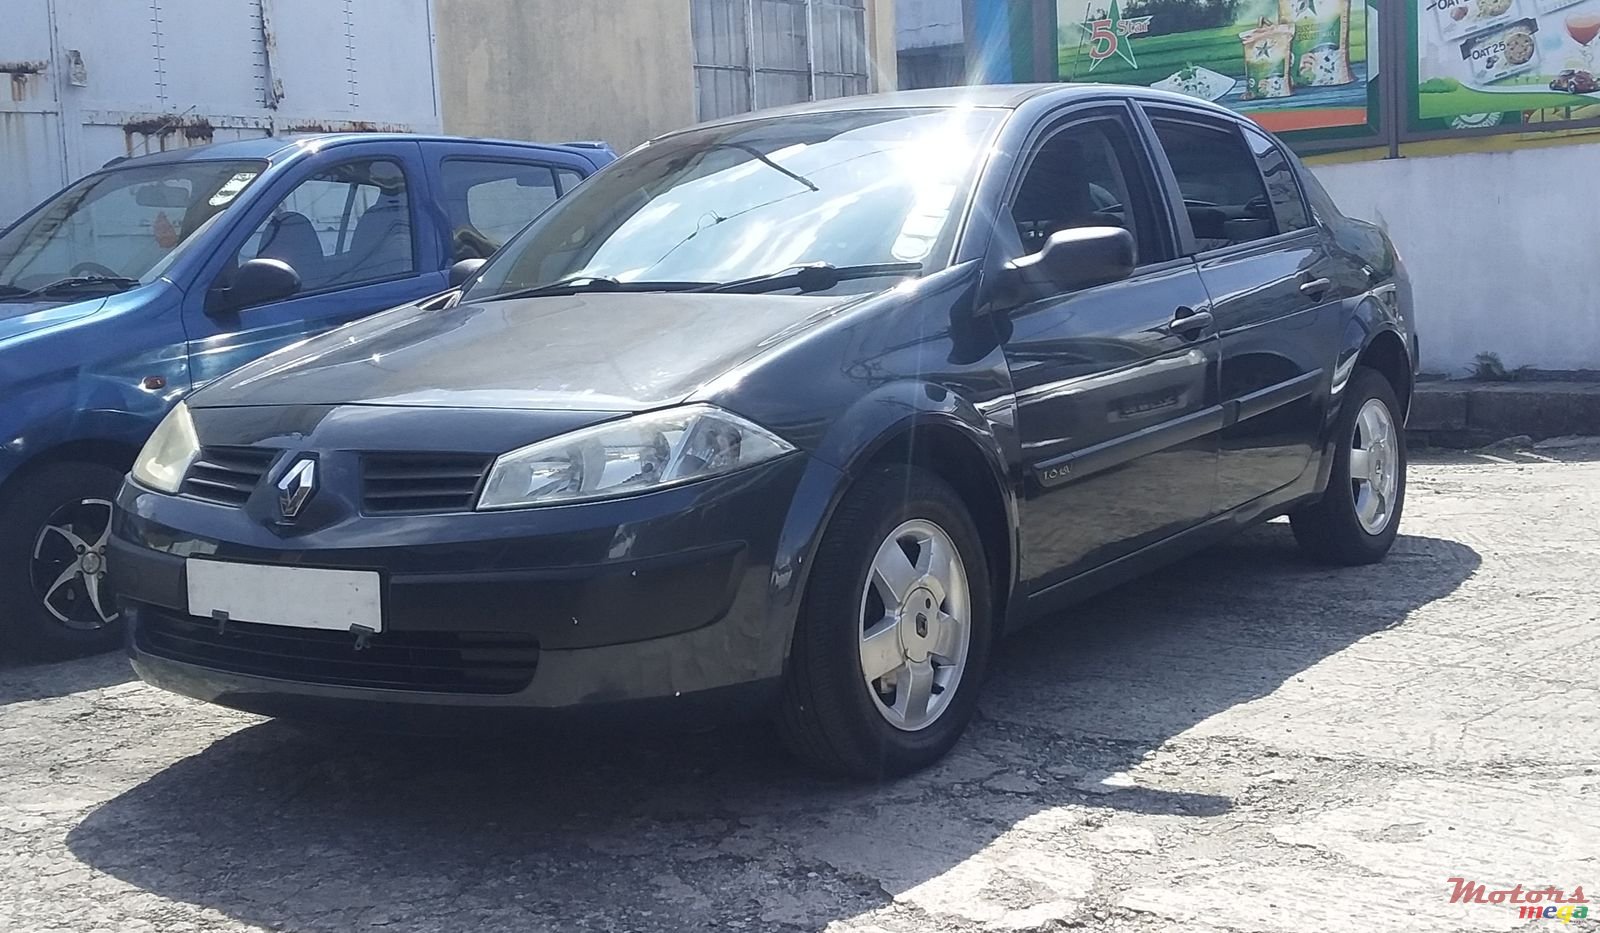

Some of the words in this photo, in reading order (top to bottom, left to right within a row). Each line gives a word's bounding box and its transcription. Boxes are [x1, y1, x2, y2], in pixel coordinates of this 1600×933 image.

[1089, 18, 1117, 60] 5
[1116, 19, 1150, 36] Star
[1472, 46, 1491, 60] OAT
[1492, 41, 1506, 53] 25
